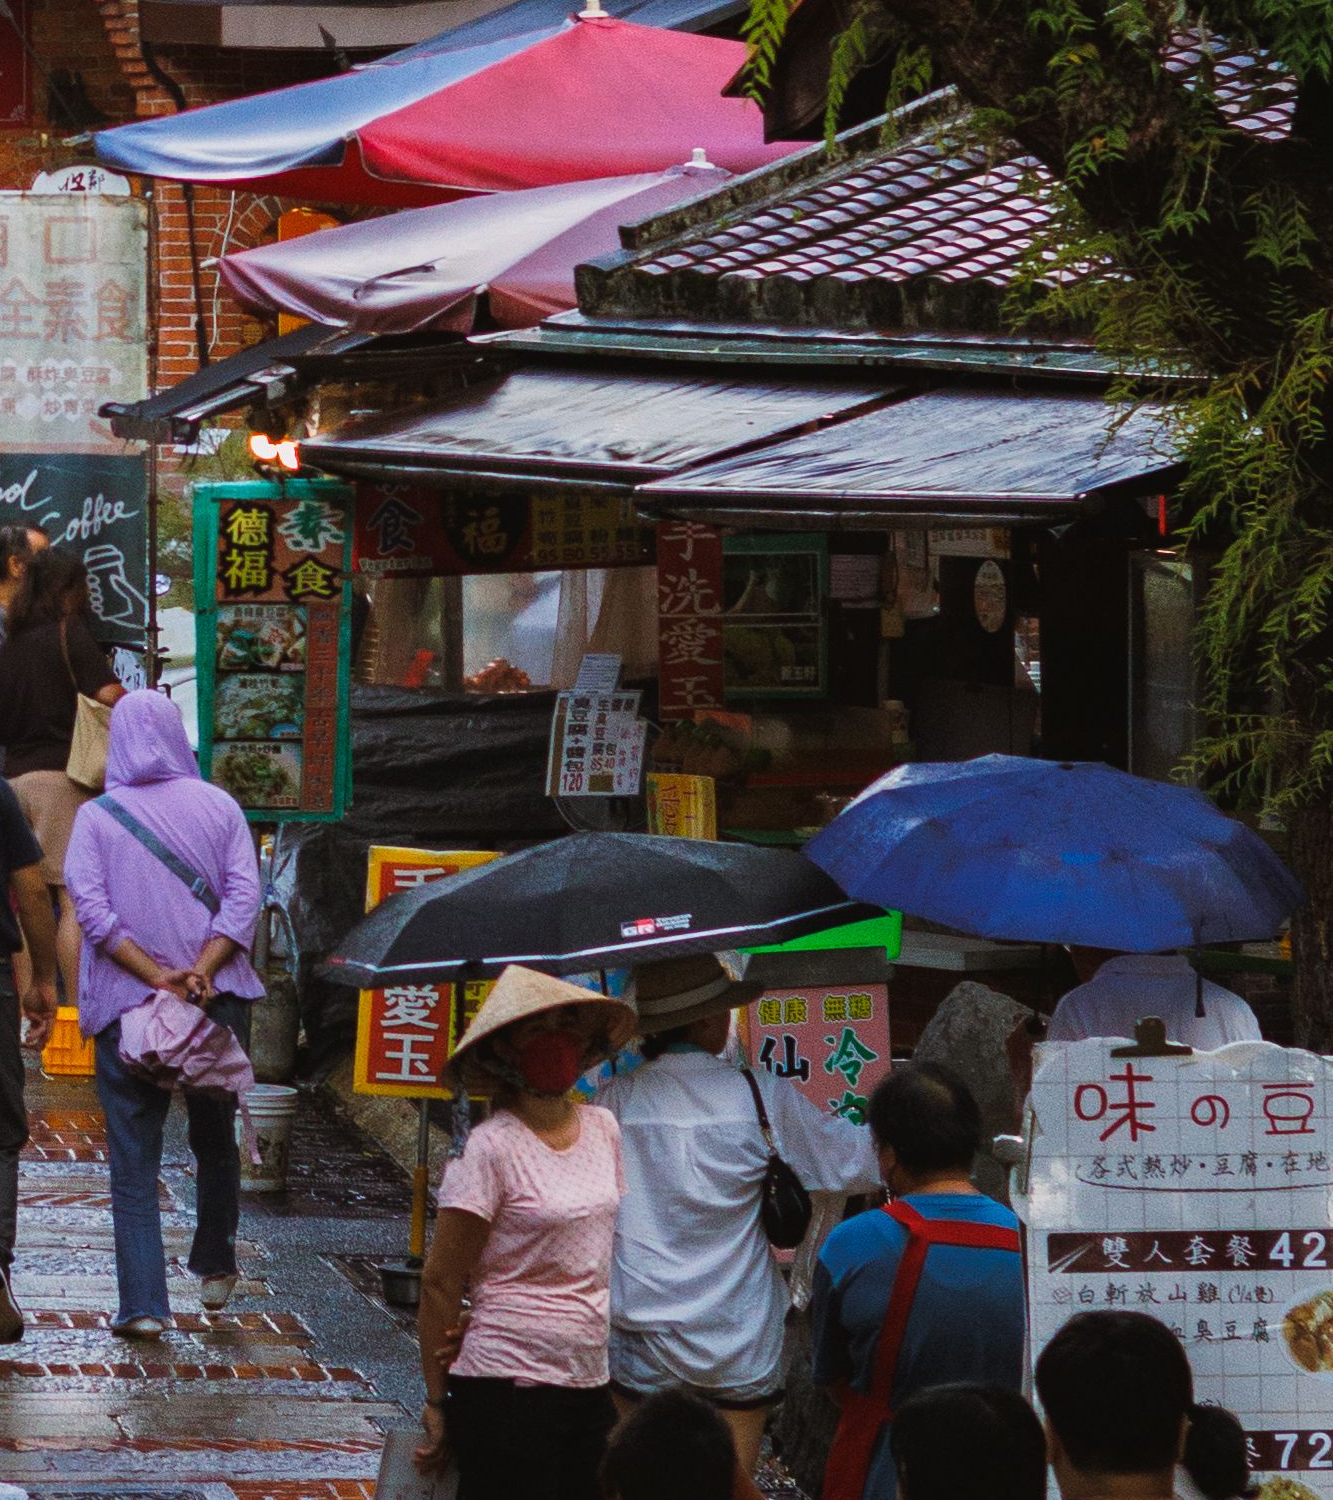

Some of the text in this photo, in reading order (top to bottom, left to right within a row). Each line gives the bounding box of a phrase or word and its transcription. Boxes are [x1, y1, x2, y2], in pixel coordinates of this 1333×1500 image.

[225, 508, 270, 589] 德福
[277, 501, 346, 596] 素食
[757, 993, 873, 1026] 健康 無糖
[1101, 1235, 1257, 1269] 雙人套餐
